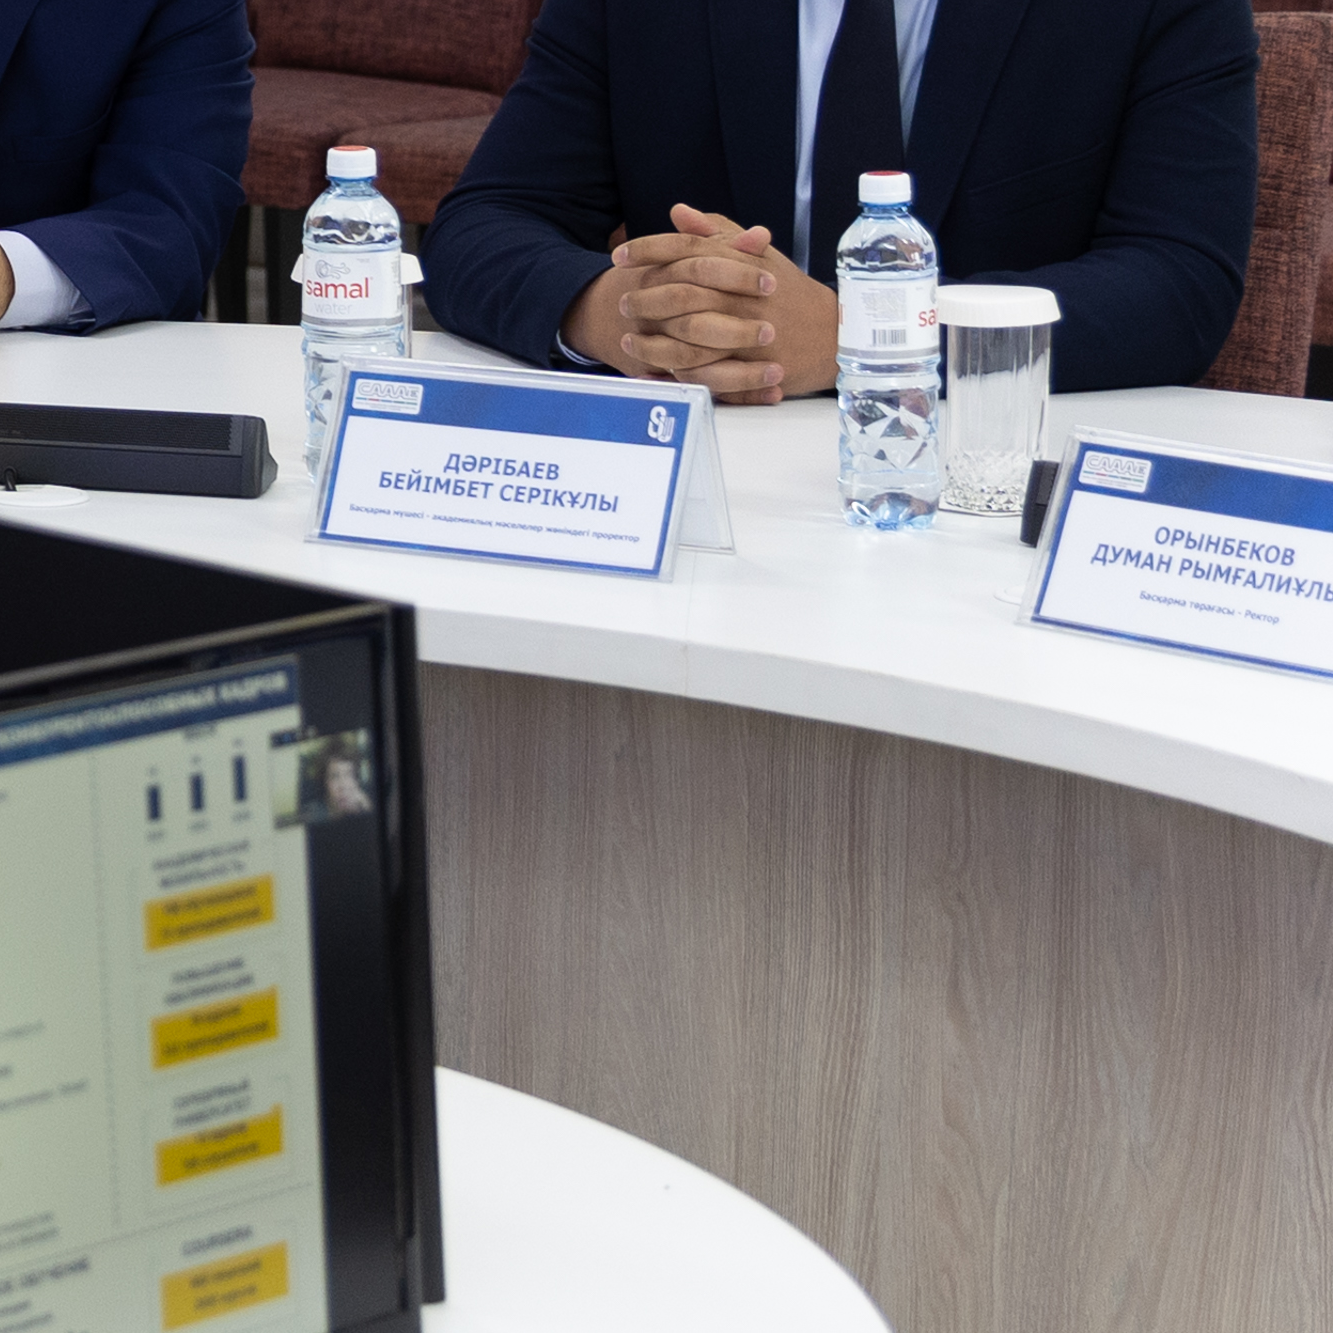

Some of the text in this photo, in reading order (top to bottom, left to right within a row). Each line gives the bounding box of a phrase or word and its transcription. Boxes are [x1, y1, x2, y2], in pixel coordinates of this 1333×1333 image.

[306, 277, 369, 299] samal
[314, 302, 353, 314] water
[443, 452, 560, 481] ДӘРІБАЕВ
[379, 470, 619, 513] БЕЙІМБЕТ СЕРІКҰЛЫ
[592, 530, 641, 544] проректор
[1154, 526, 1296, 566] ОРЫНБЕКОВ
[1090, 543, 1173, 574] ДУМАН
[1139, 590, 1187, 608] Басқарма
[1244, 609, 1280, 625] Ректор
